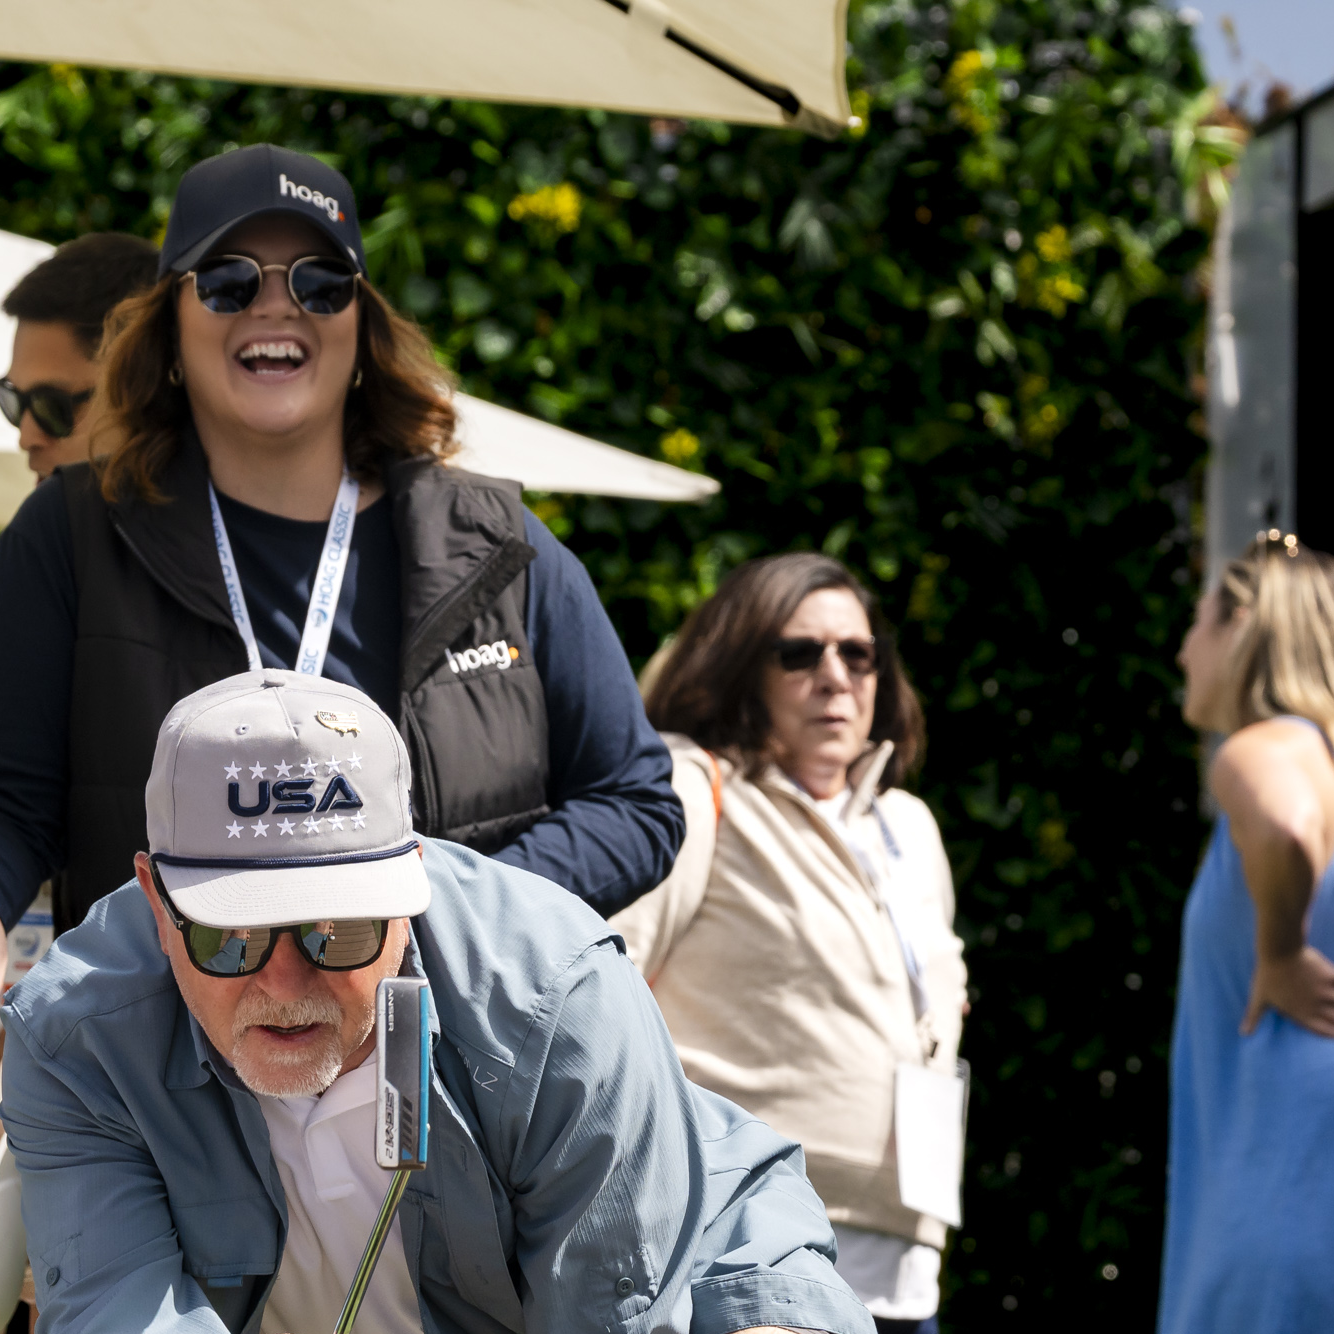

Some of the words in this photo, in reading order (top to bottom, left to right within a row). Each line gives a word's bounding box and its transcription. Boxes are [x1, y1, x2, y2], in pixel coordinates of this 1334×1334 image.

[327, 501, 351, 563] CLASSIC
[318, 563, 337, 606] HOAG
[228, 774, 364, 817] USA
[387, 987, 395, 1033] ANSER
